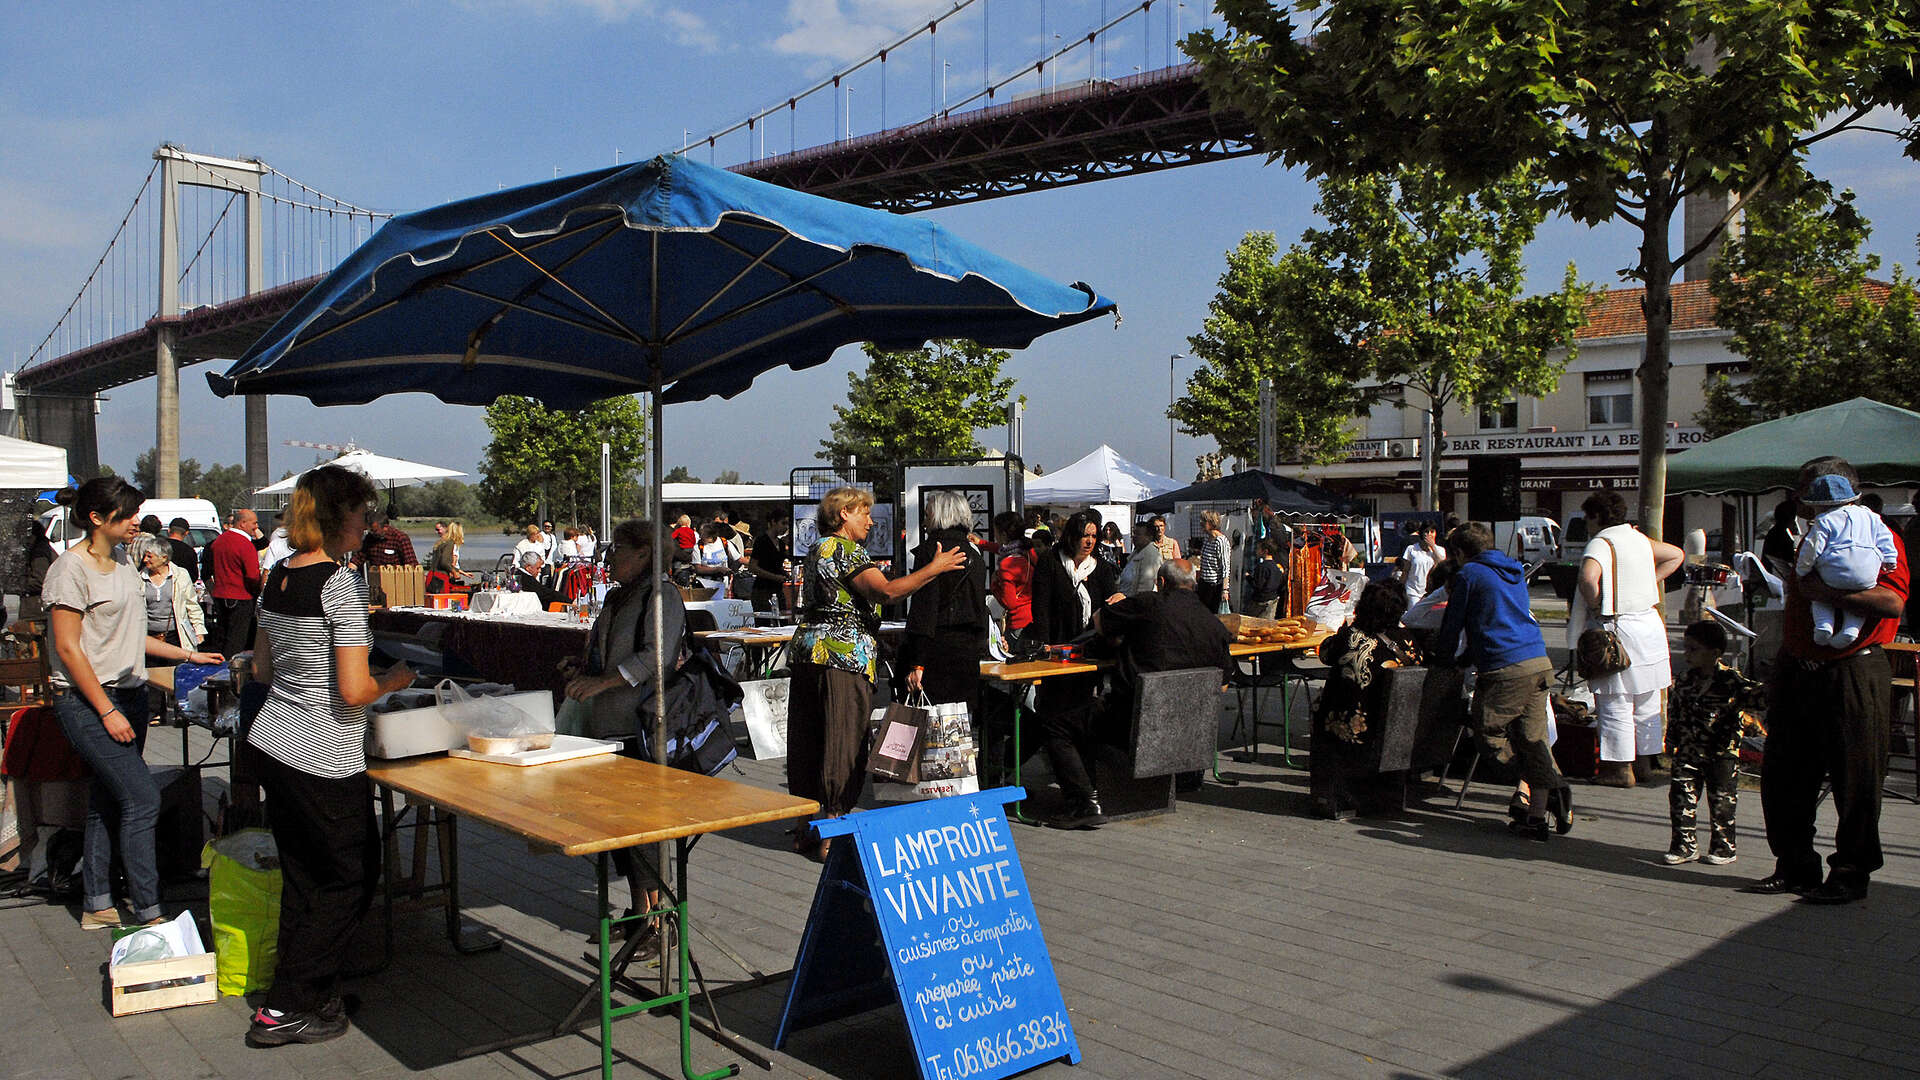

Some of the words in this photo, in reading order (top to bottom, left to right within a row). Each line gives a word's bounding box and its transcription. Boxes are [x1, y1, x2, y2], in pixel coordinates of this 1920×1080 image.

[1452, 440, 1481, 451] BAR
[1487, 436, 1585, 450] RESTAURANT
[1591, 435, 1611, 446] LA
[1677, 431, 1712, 444] ROS
[1588, 479, 1604, 488] LA
[871, 815, 1008, 878] LAMPROIE
[882, 858, 1020, 925] VIVANTE
[898, 926, 960, 964] cuisinée
[960, 929, 974, 946] à
[973, 906, 1032, 956] emporter
[948, 913, 980, 933] ou
[961, 953, 994, 976] ou
[915, 972, 982, 1024] préparée
[990, 952, 1035, 998] prête
[934, 1007, 953, 1030] à
[958, 991, 1017, 1022] cuire
